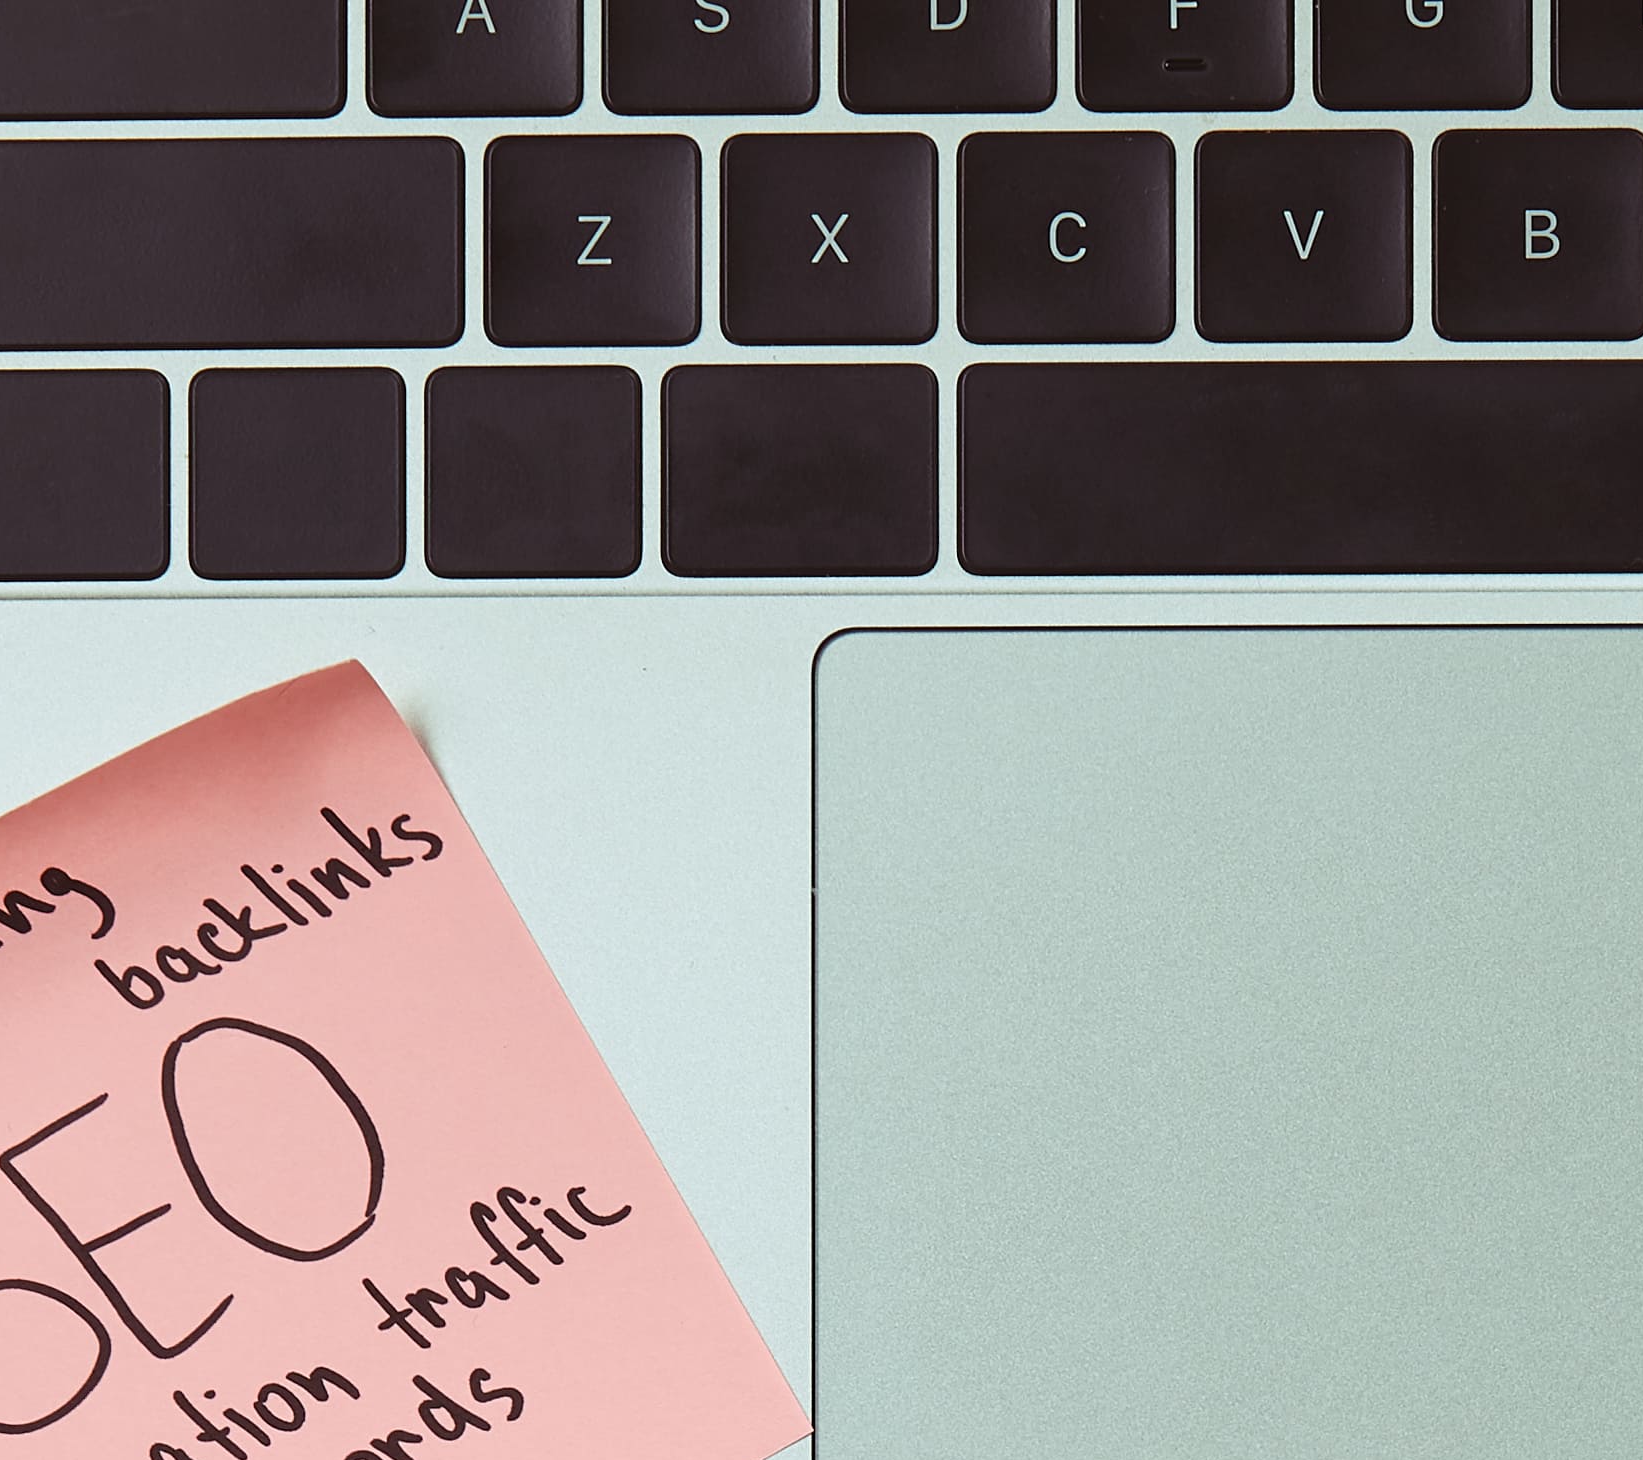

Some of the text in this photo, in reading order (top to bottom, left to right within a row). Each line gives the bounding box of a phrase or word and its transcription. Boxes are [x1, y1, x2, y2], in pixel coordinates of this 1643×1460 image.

[456, 0, 496, 34] A
[694, 0, 730, 34] S
[577, 215, 612, 265] Z
[811, 213, 849, 264] X
[1049, 211, 1087, 263] C
[1283, 210, 1324, 260] V
[1525, 209, 1560, 259] B
[92, 805, 444, 1011] backlinks
[361, 1185, 633, 1350] traffic
